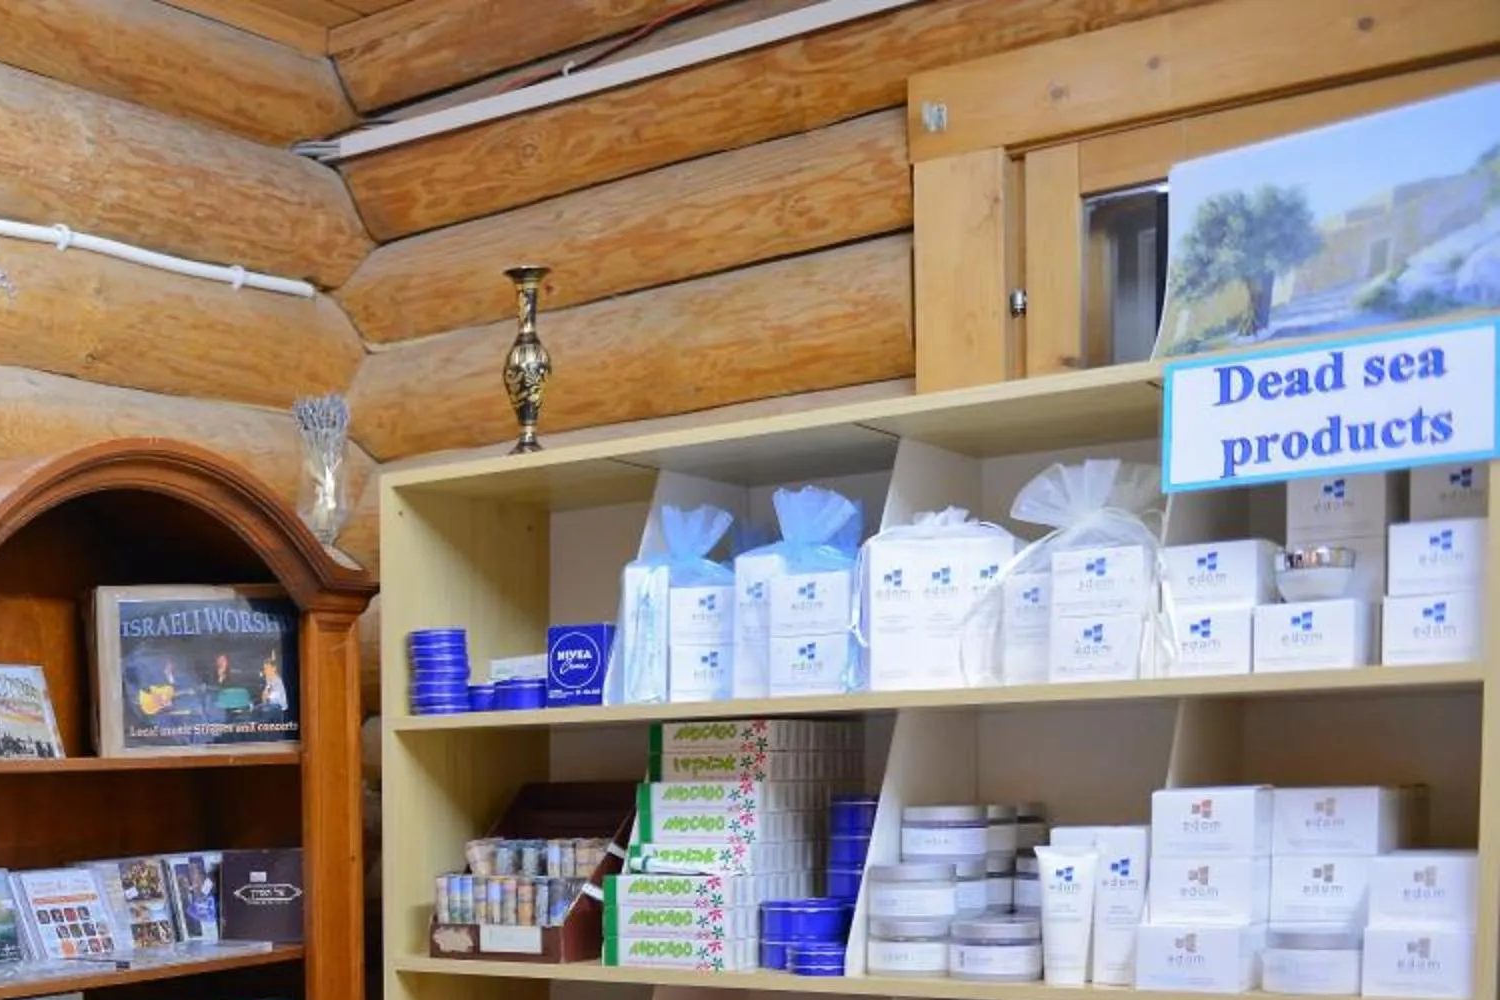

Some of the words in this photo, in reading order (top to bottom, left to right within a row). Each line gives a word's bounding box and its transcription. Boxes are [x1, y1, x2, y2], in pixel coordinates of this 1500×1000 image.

[1213, 351, 1346, 406] Dead
[1363, 345, 1446, 387] sea
[1219, 405, 1454, 479] products
[1187, 571, 1228, 585] edom
[122, 609, 200, 637] ISRAELI
[557, 650, 592, 661] NIVEA
[1182, 819, 1222, 833] edom
[1304, 817, 1346, 829] edom
[1180, 884, 1219, 898] edom
[1403, 886, 1446, 900] edom
[1167, 951, 1206, 965] edom
